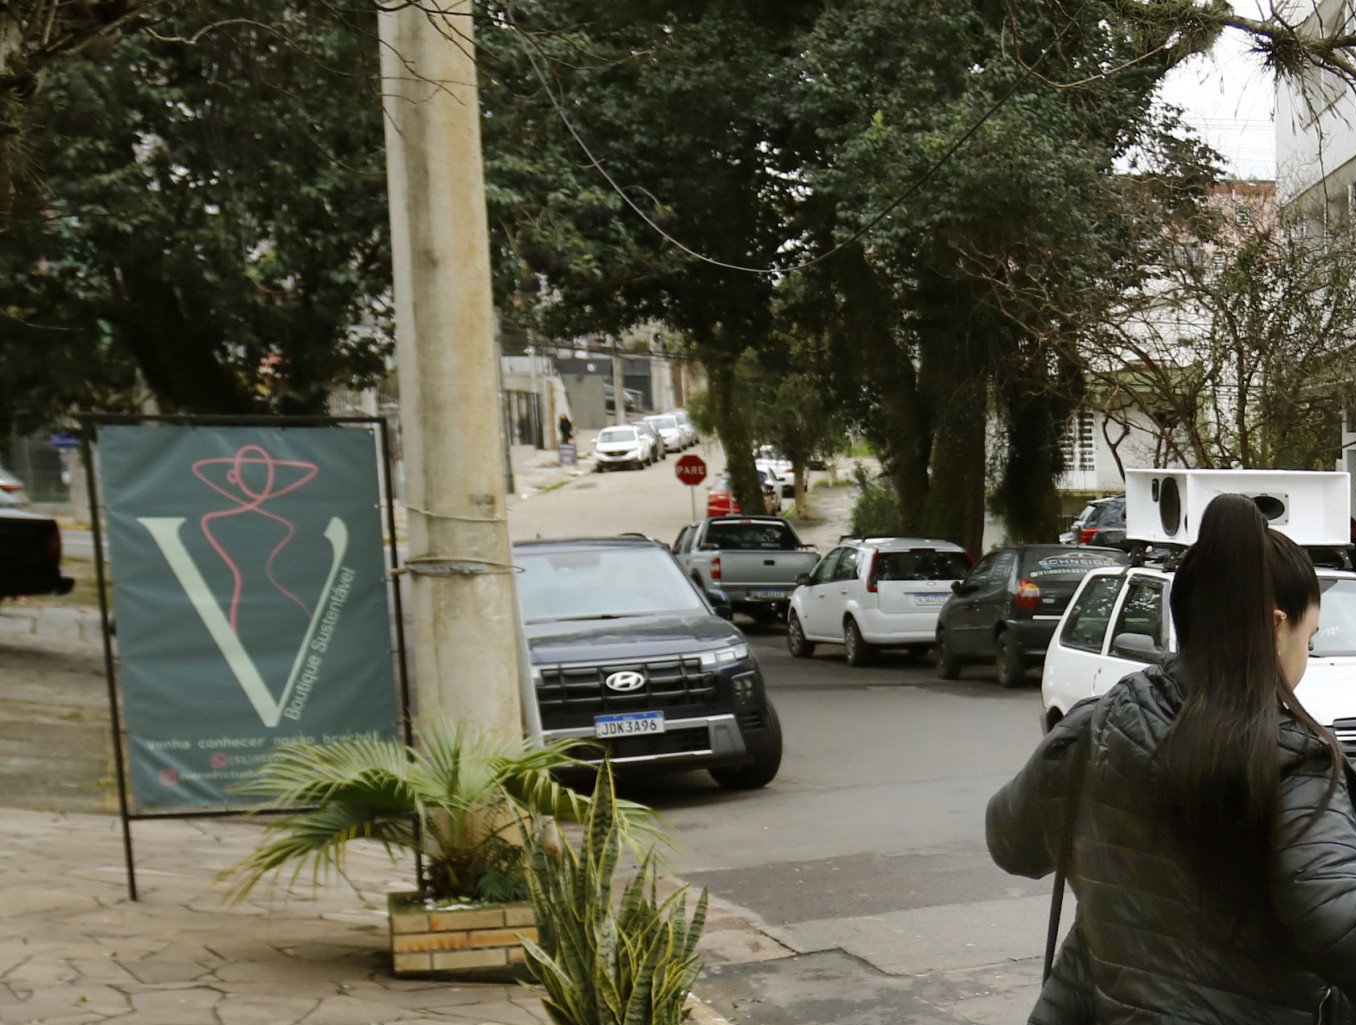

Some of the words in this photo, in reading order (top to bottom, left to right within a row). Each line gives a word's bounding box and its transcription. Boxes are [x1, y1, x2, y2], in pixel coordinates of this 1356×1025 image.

[676, 465, 704, 475] PARE
[136, 516, 349, 727] V
[284, 654, 321, 720] Boutique
[311, 566, 356, 653] Sustentável
[601, 720, 657, 735] JDK3A96
[198, 737, 264, 749] conhecer
